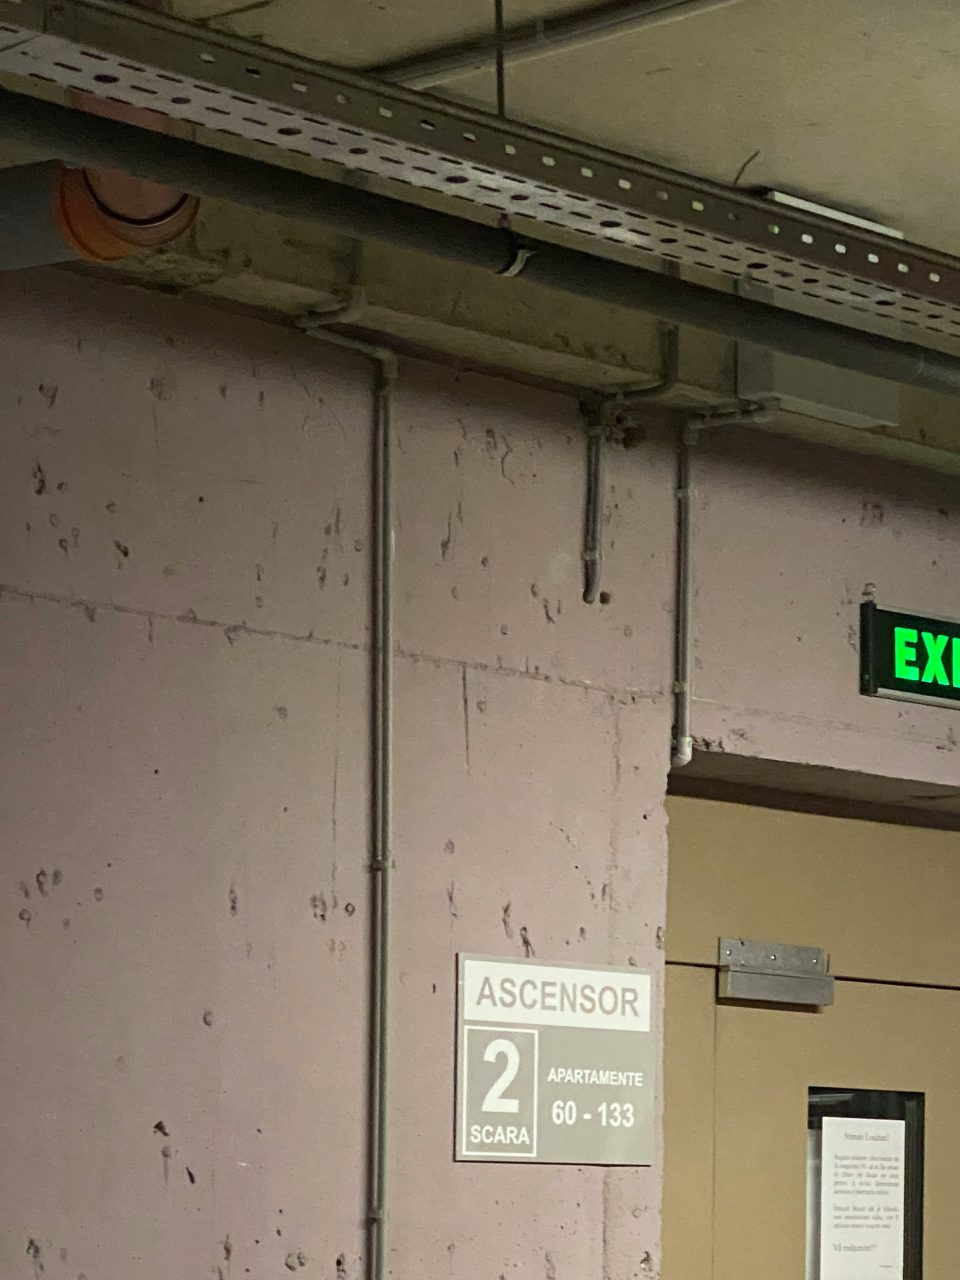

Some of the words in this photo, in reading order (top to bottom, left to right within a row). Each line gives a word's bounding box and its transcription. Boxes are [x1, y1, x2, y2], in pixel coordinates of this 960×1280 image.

[475, 975, 641, 1018] ASCENSOR
[481, 1038, 520, 1114] 2
[546, 1067, 644, 1087] APARTAMENTE
[552, 1100, 577, 1125] 60
[598, 1102, 635, 1128] 133
[470, 1124, 530, 1145] SCARA
